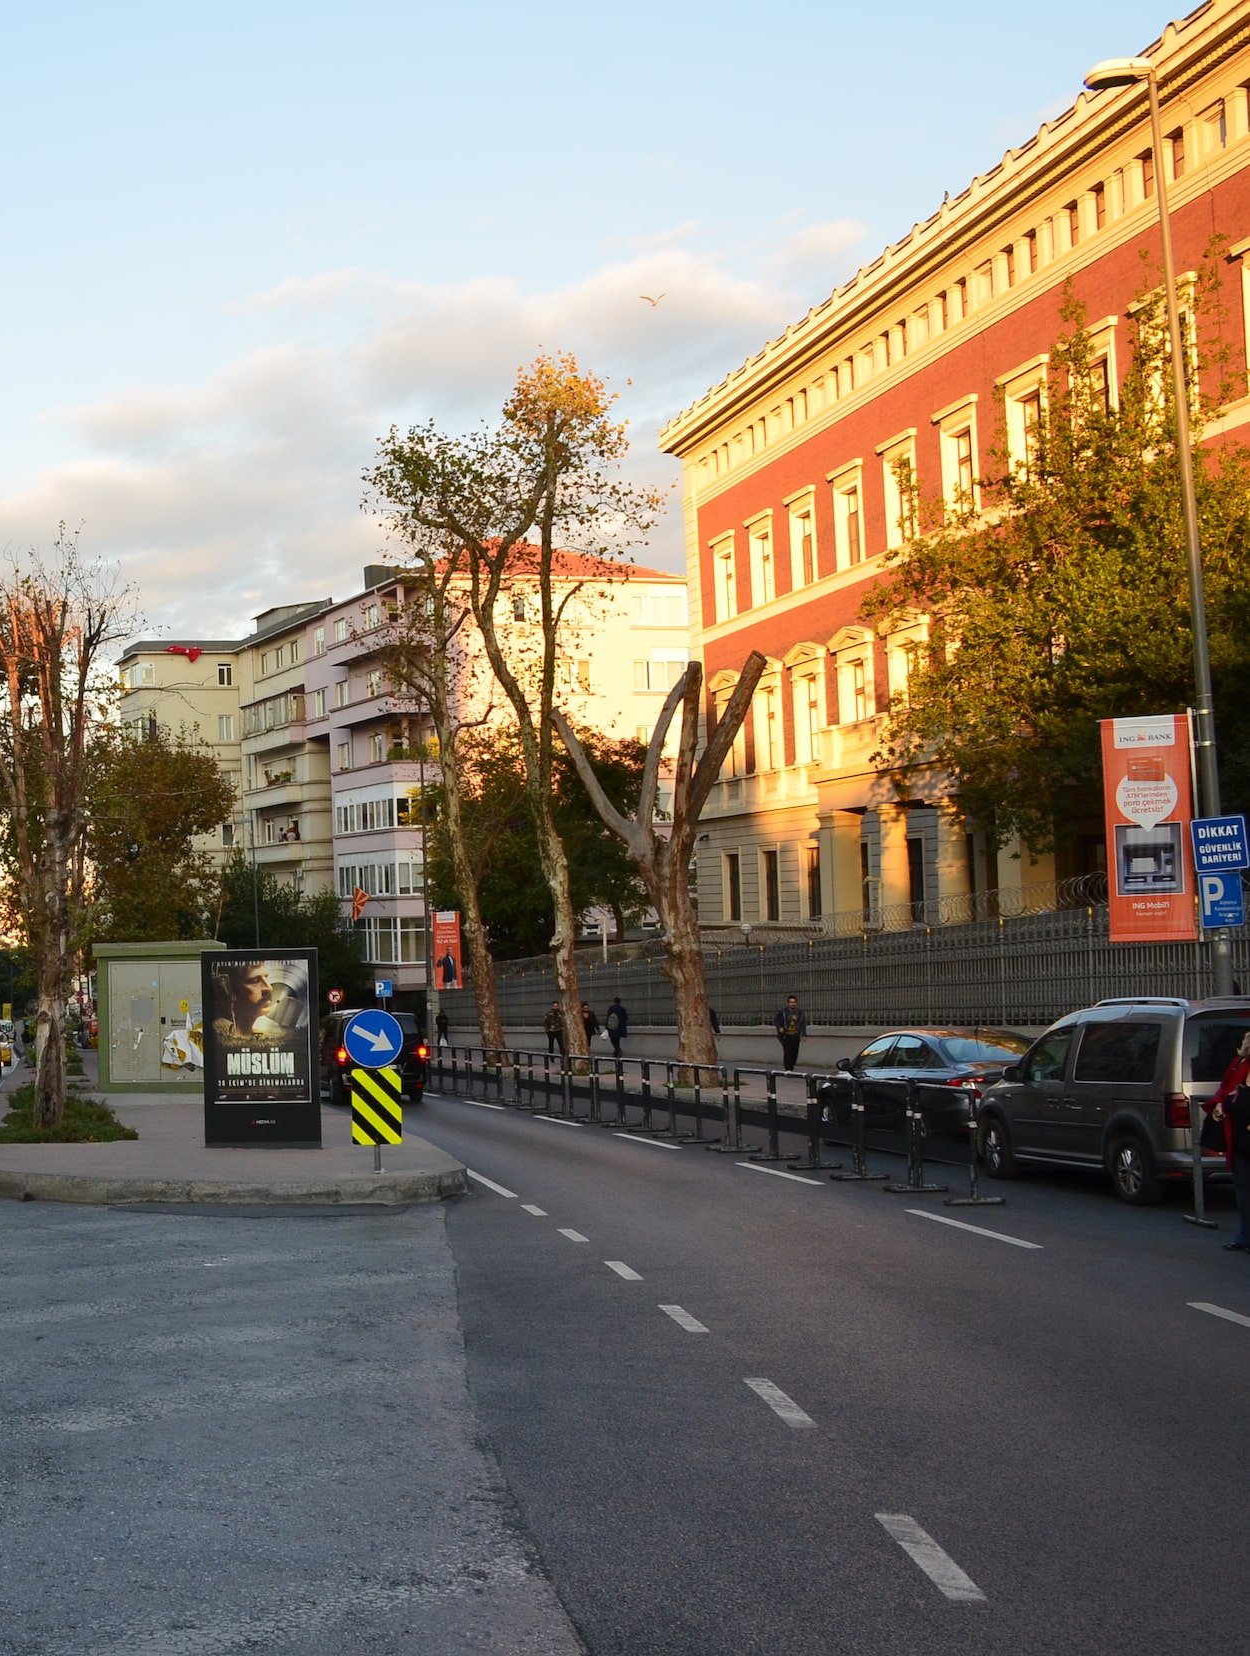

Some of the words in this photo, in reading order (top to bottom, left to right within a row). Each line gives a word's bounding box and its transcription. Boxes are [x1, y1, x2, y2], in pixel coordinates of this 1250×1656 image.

[1148, 733, 1172, 741] BANK
[1123, 800, 1141, 808] para
[1142, 798, 1172, 808] çekmek
[1198, 825, 1239, 839] DİKKAT
[1199, 841, 1242, 854] GÜVENLİK
[1201, 852, 1242, 864] BARİYERİ
[1202, 876, 1224, 916] P
[1132, 902, 1146, 910] ING
[227, 1047, 295, 1076] MÜSLÜM
